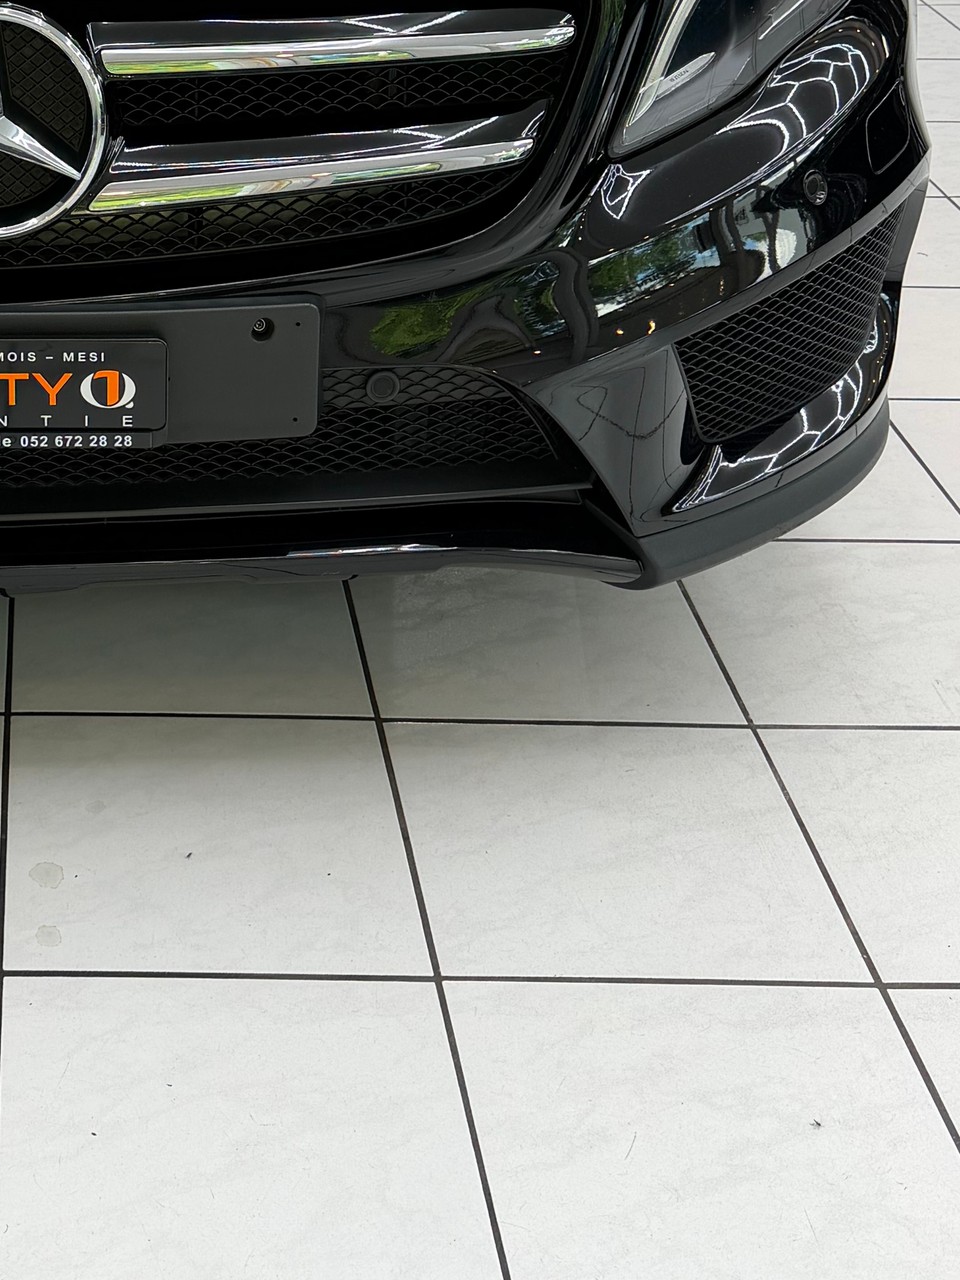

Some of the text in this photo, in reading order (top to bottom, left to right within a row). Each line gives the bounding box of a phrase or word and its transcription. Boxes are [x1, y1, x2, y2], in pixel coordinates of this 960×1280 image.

[62, 351, 106, 362] MESI
[20, 434, 49, 448] 052
[54, 434, 83, 448] 672
[89, 434, 108, 448] 28
[114, 434, 133, 448] 28
